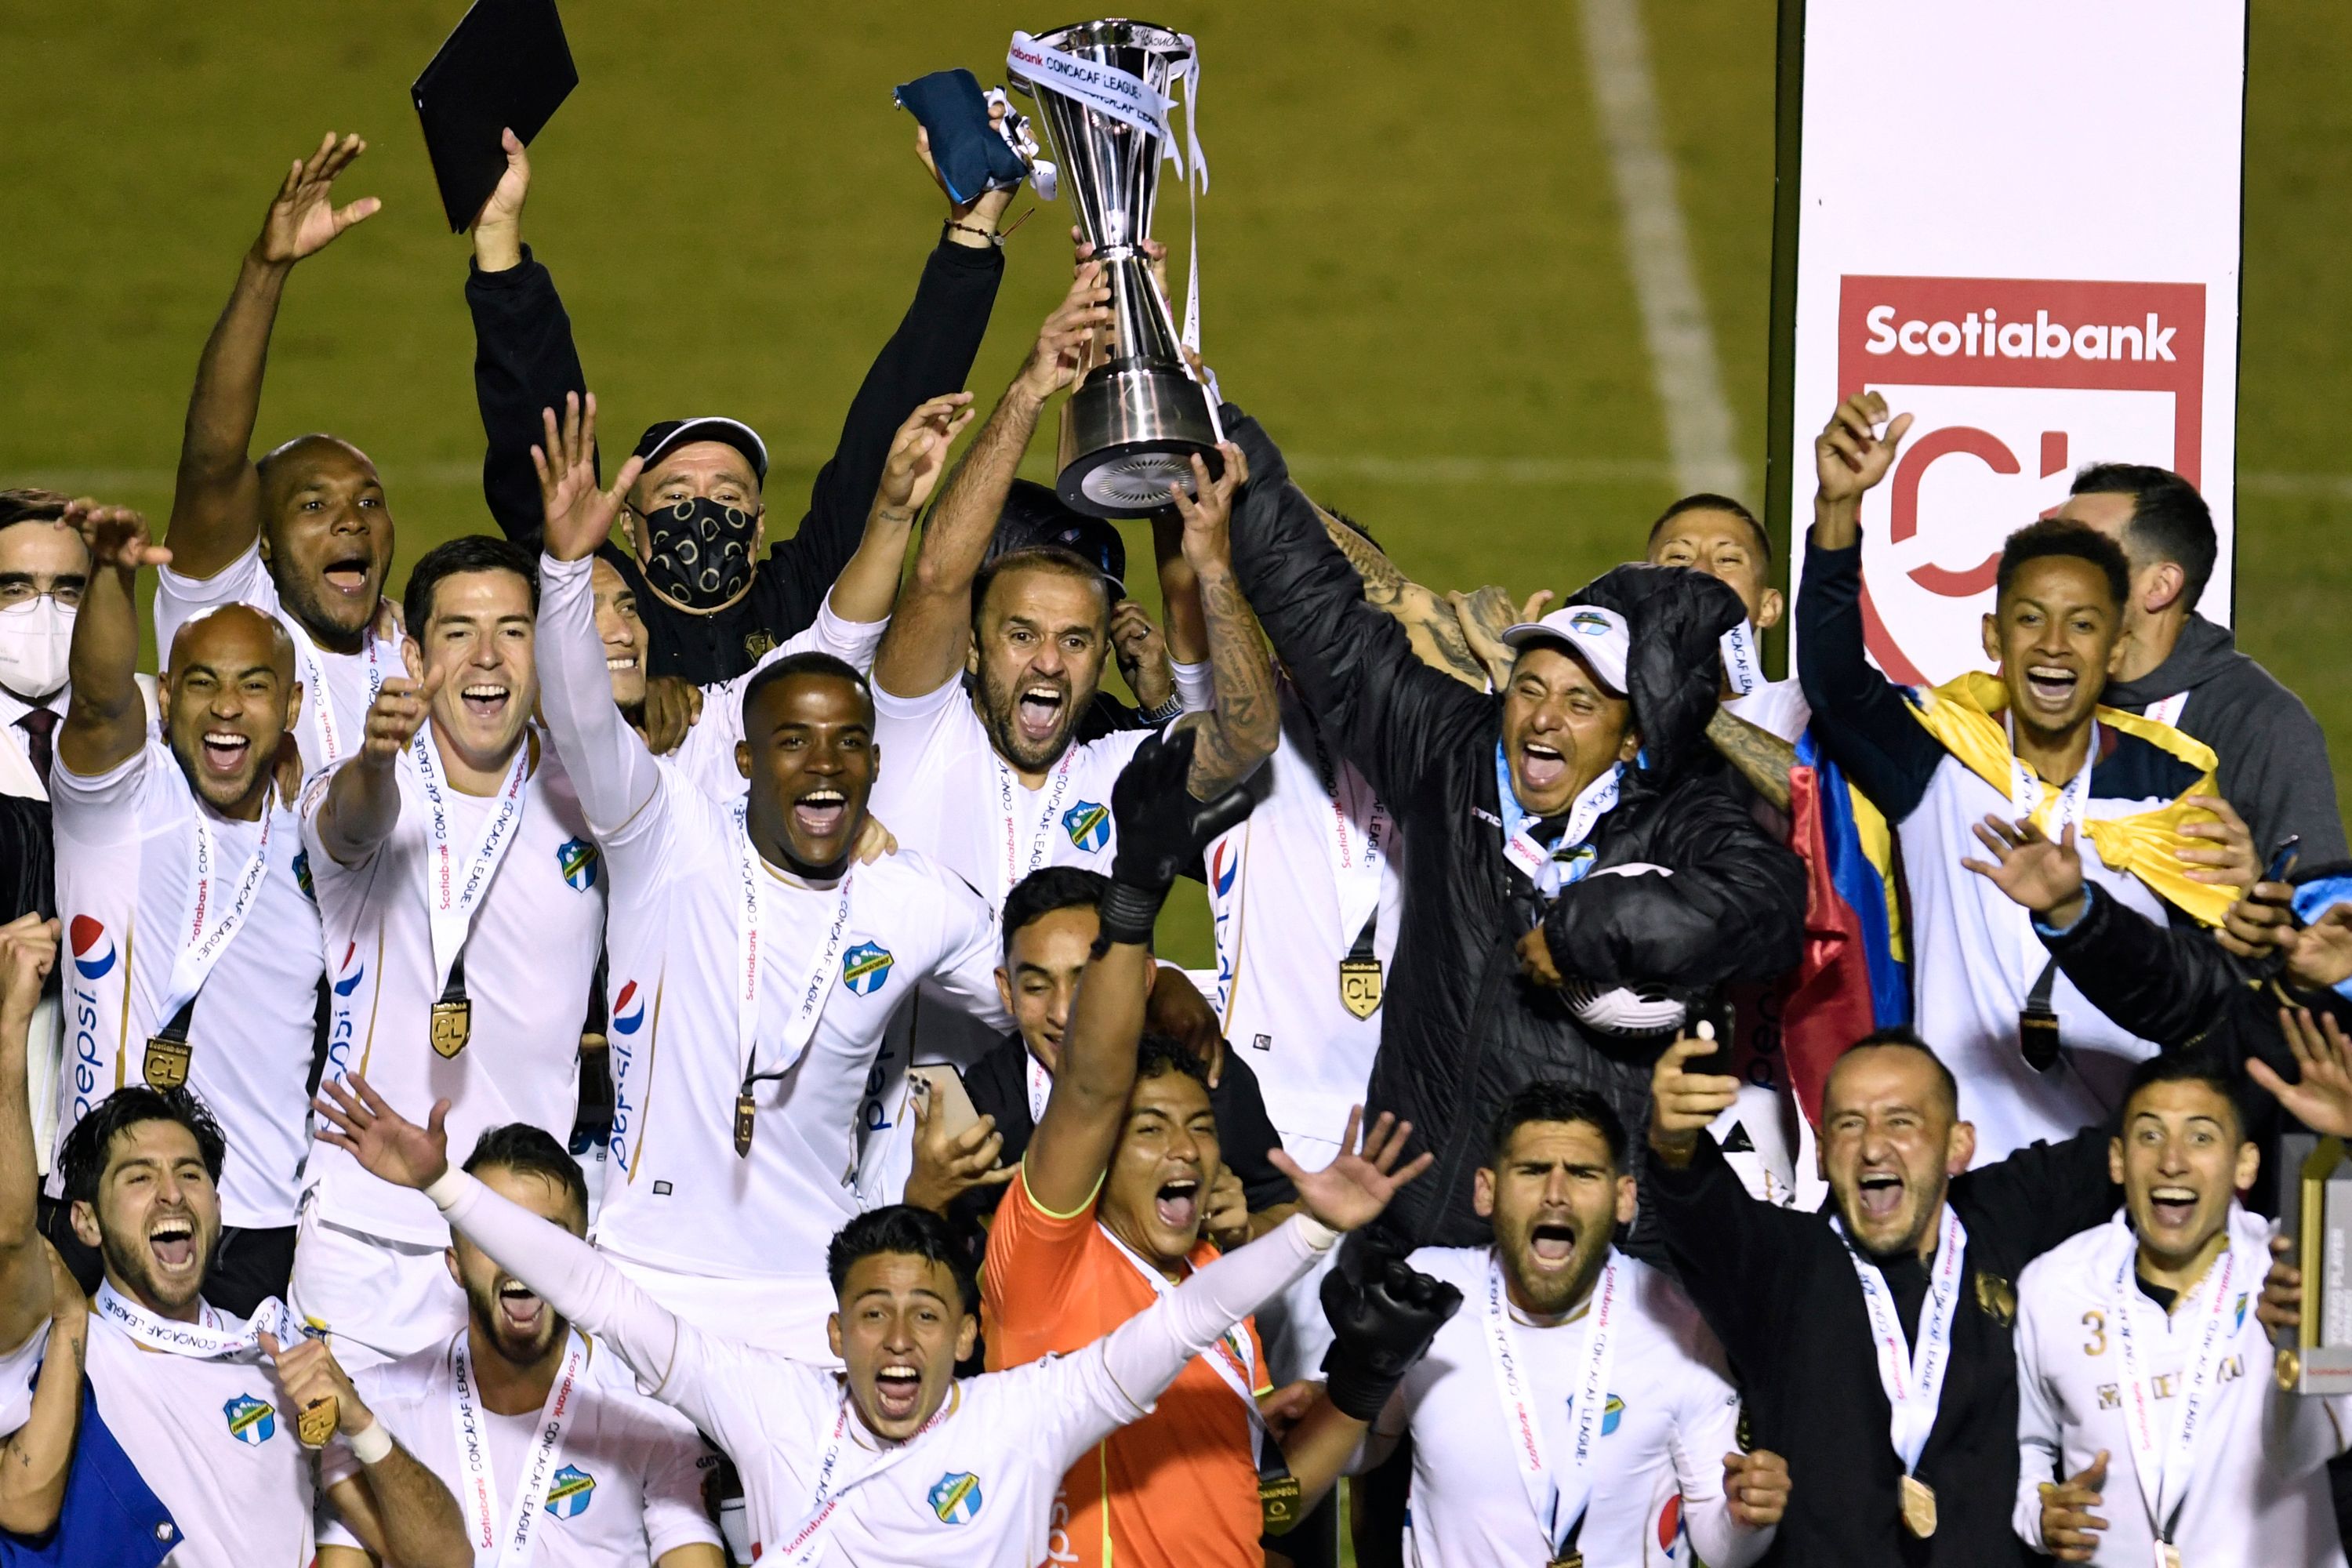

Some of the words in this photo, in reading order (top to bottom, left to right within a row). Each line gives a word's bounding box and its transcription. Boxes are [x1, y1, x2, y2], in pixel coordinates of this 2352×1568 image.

[1047, 56, 1101, 85] CONCACAF
[1864, 304, 2177, 362] Scotiabank
[426, 782, 446, 840] CONCACAF
[481, 801, 514, 858] CONCACAF
[1040, 775, 1069, 831] CONCACAF
[1029, 833, 1047, 873] LEAGU
[1331, 801, 1352, 869] Scotiabank
[235, 850, 265, 916] CONCACAF
[437, 844, 450, 910] Scotiabank
[187, 878, 208, 948] cotiabank
[822, 900, 848, 967] CONCACAF
[746, 928, 757, 1001] Scotiabank
[1347, 978, 1377, 1000] CL
[74, 987, 103, 1125] pepsi
[434, 1018, 463, 1041] CL
[149, 1055, 182, 1081] CL
[146, 1325, 217, 1351] CONCACAF
[552, 1351, 581, 1418] Scotiabank
[461, 1403, 482, 1472] CONCACAF
[530, 1421, 560, 1492] CONCACAF
[476, 1477, 492, 1548] Scotiabank
[782, 1501, 837, 1555] Scotiabank
